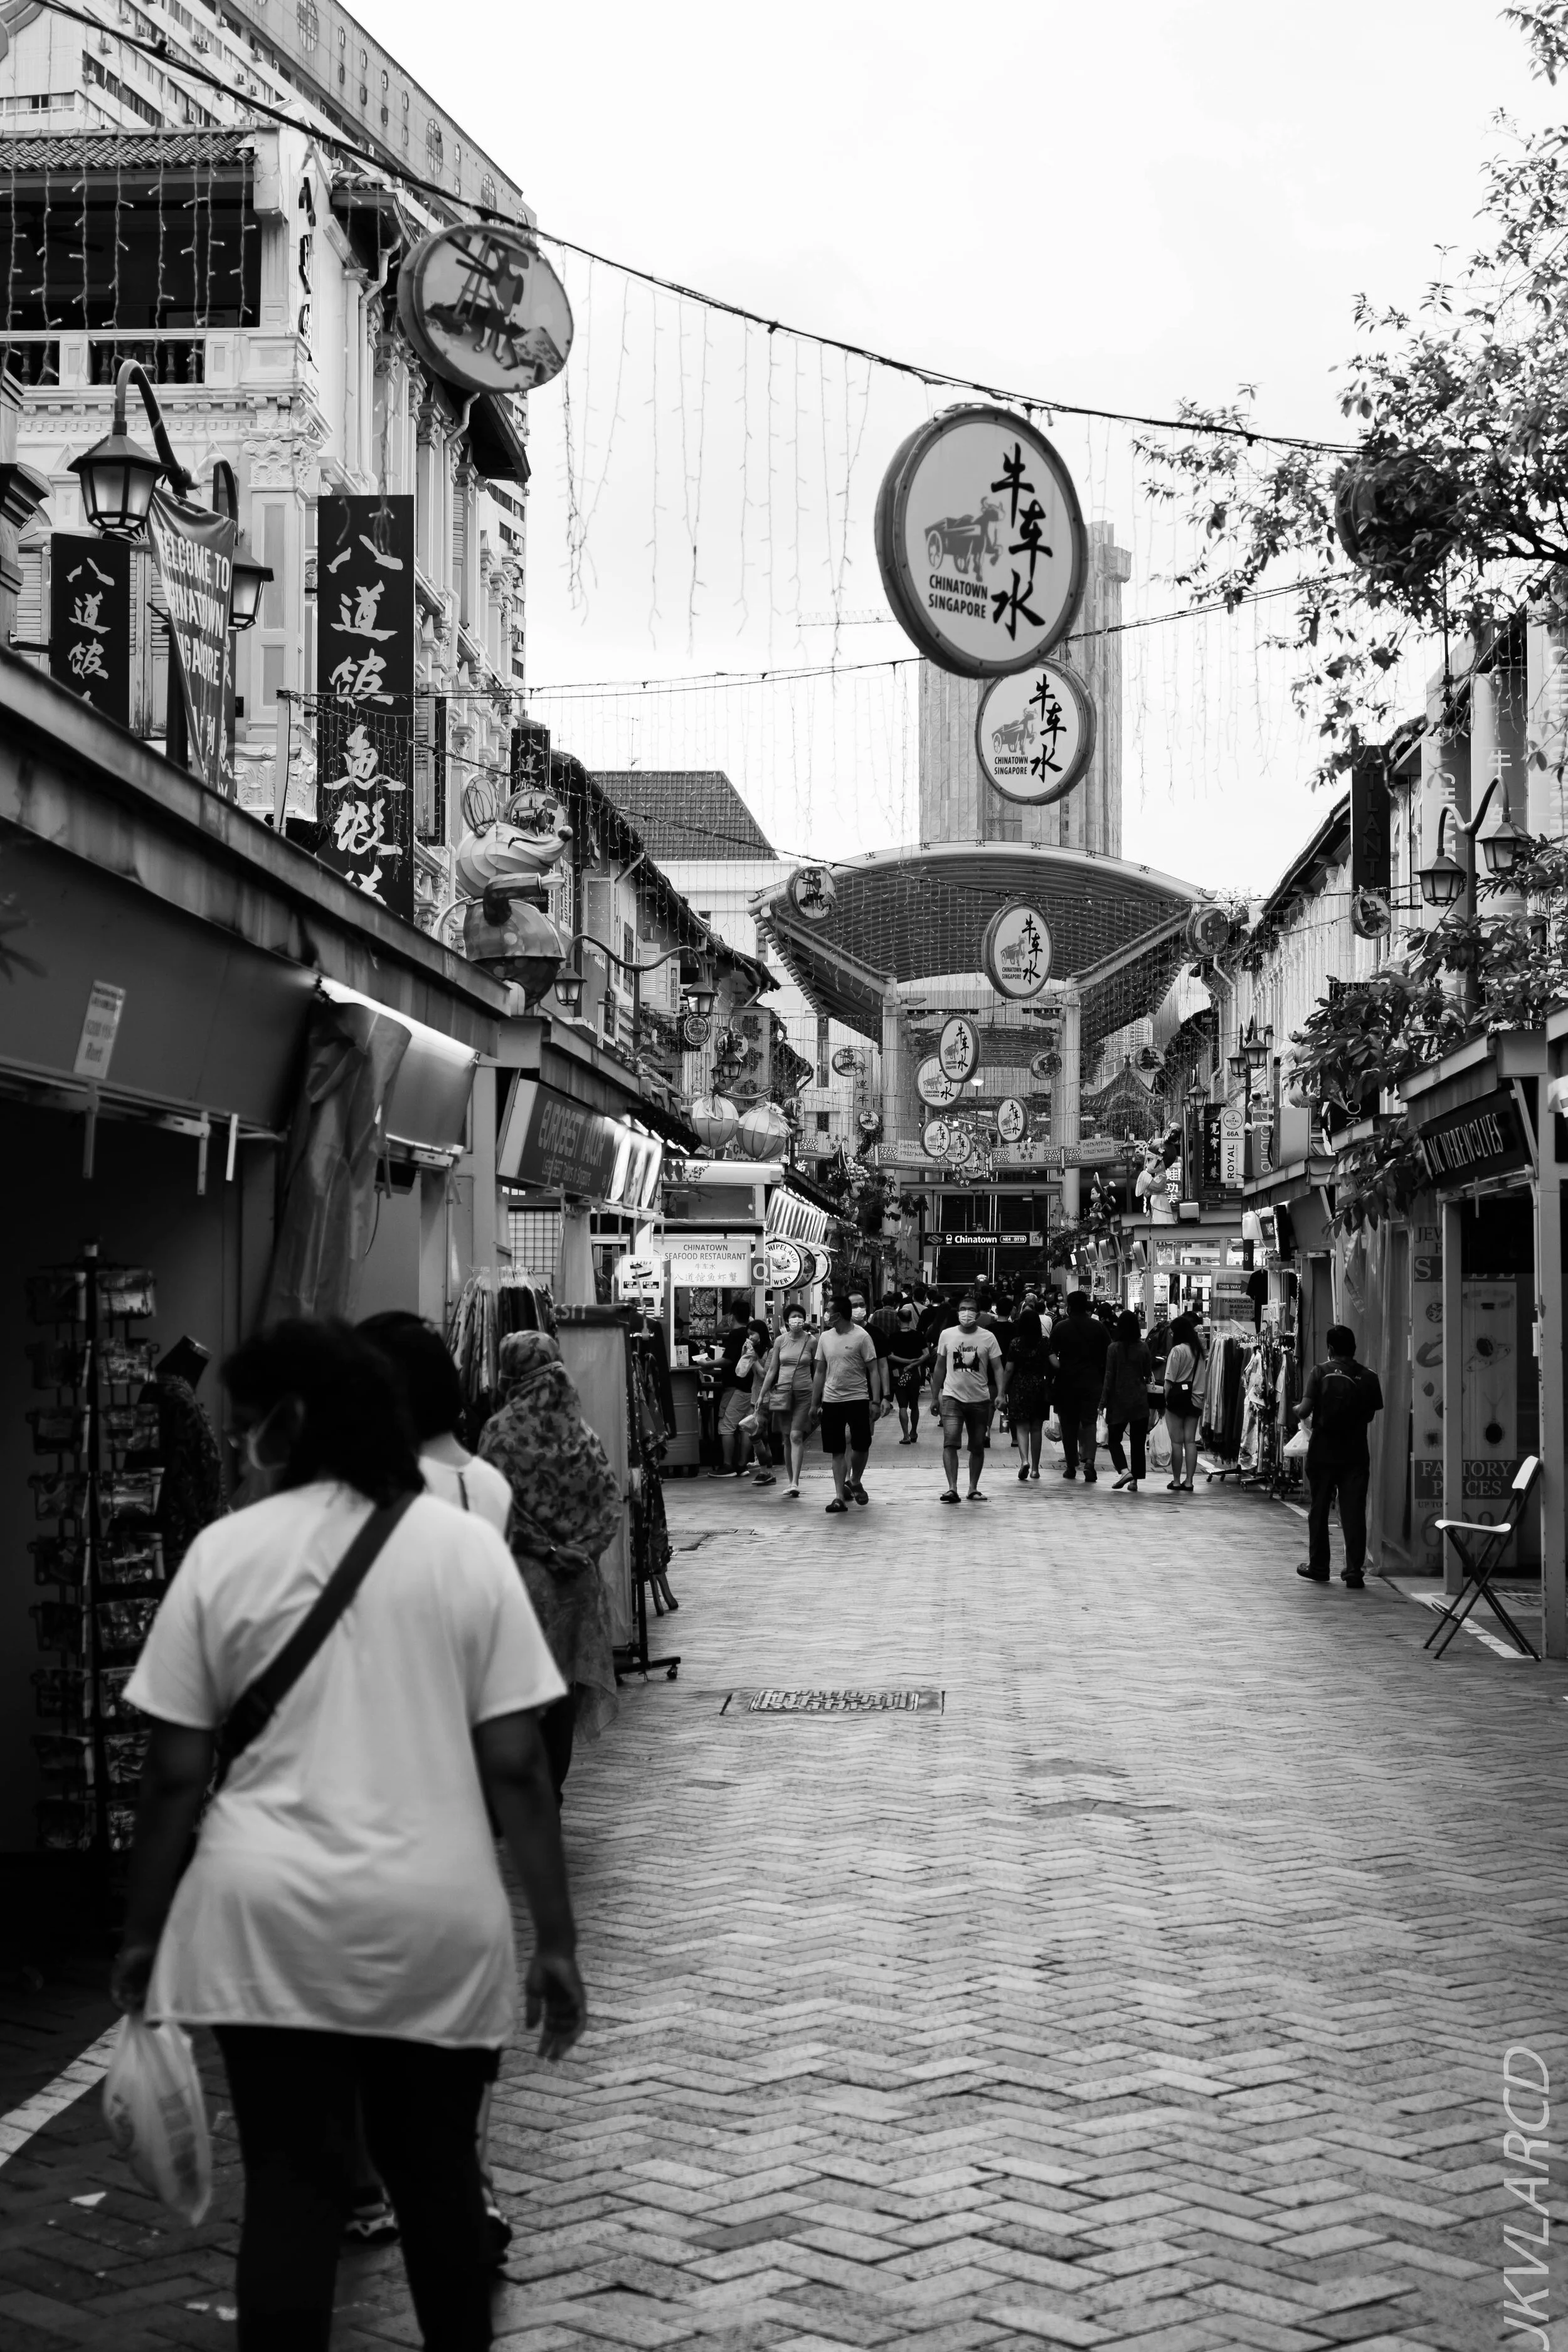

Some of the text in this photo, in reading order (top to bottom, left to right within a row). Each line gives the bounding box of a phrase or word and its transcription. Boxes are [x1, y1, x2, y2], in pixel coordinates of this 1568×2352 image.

[215, 553, 230, 593] TO
[929, 574, 988, 600] CHINATOWN
[928, 593, 987, 619] SINGAPORE
[994, 756, 1028, 765] CHINATOWN
[993, 765, 1027, 775] SINGAPORE
[538, 1100, 585, 1158] EUROBEST
[1083, 1140, 1111, 1148] CHINATOWN
[955, 1235, 997, 1243] Chinatown
[753, 1263, 770, 1281] Q
[1421, 1461, 1513, 1477] FATORY
[1433, 1480, 1502, 1496] PCES
